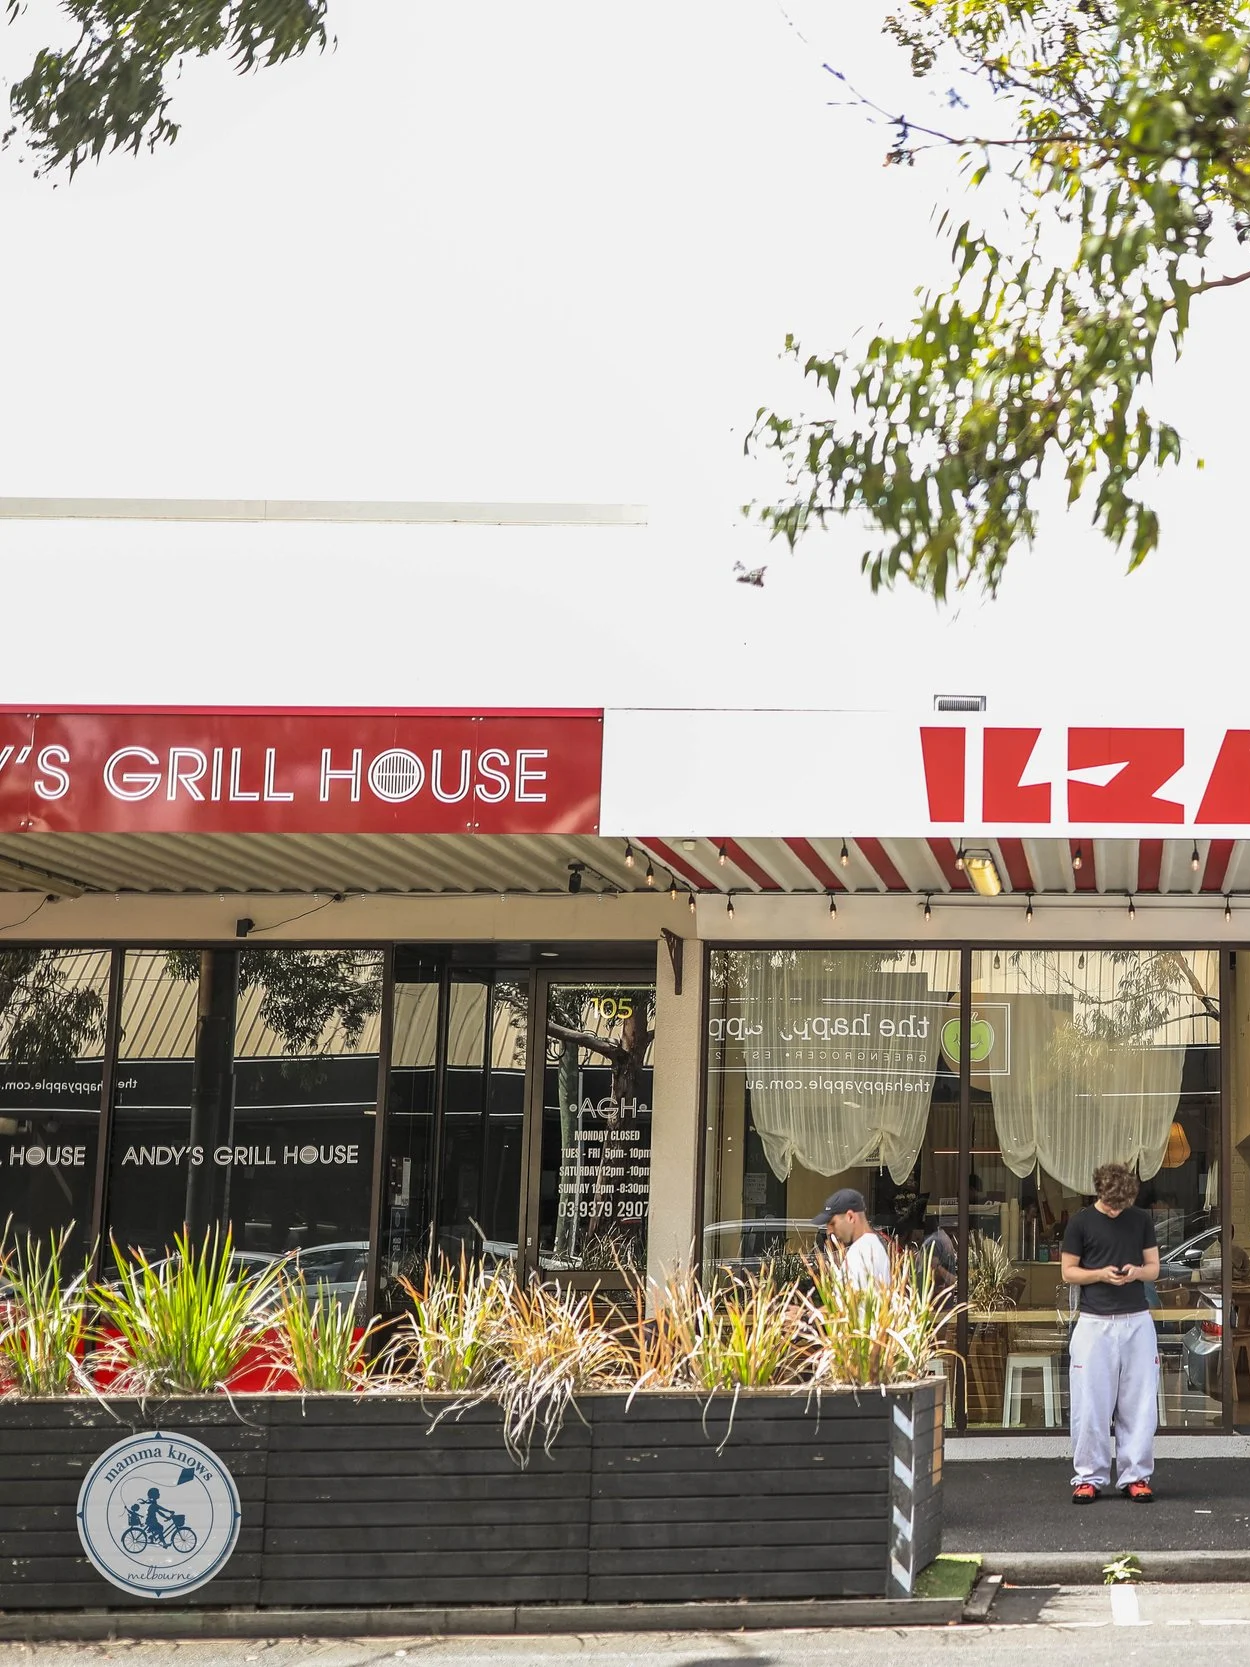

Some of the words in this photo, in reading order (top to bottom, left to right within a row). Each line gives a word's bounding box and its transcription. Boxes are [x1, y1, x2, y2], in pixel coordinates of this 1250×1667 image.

[103, 746, 294, 802] GRILL
[320, 748, 549, 804] HOUSE
[590, 997, 633, 1020] 105
[576, 1097, 638, 1119] AGH
[574, 1130, 609, 1141] MONDAY
[611, 1130, 640, 1141] CLOSED
[9, 1146, 87, 1166] HOUSE
[121, 1146, 204, 1166] ANDY'S
[213, 1145, 277, 1166] GRILL
[283, 1144, 359, 1165] HOUSE
[561, 1148, 580, 1158] TUES
[588, 1148, 600, 1158] FRI
[559, 1166, 600, 1176] SATURDAY
[601, 1166, 625, 1177] 12pm
[558, 1183, 590, 1194] SUNDAY
[591, 1184, 615, 1195] 12pm
[558, 1201, 575, 1217] 03
[580, 1201, 613, 1217] 9379
[617, 1201, 649, 1217] 2907
[104, 1446, 162, 1484] mamma
[168, 1444, 213, 1482] knows
[127, 1564, 195, 1581] melbourne
